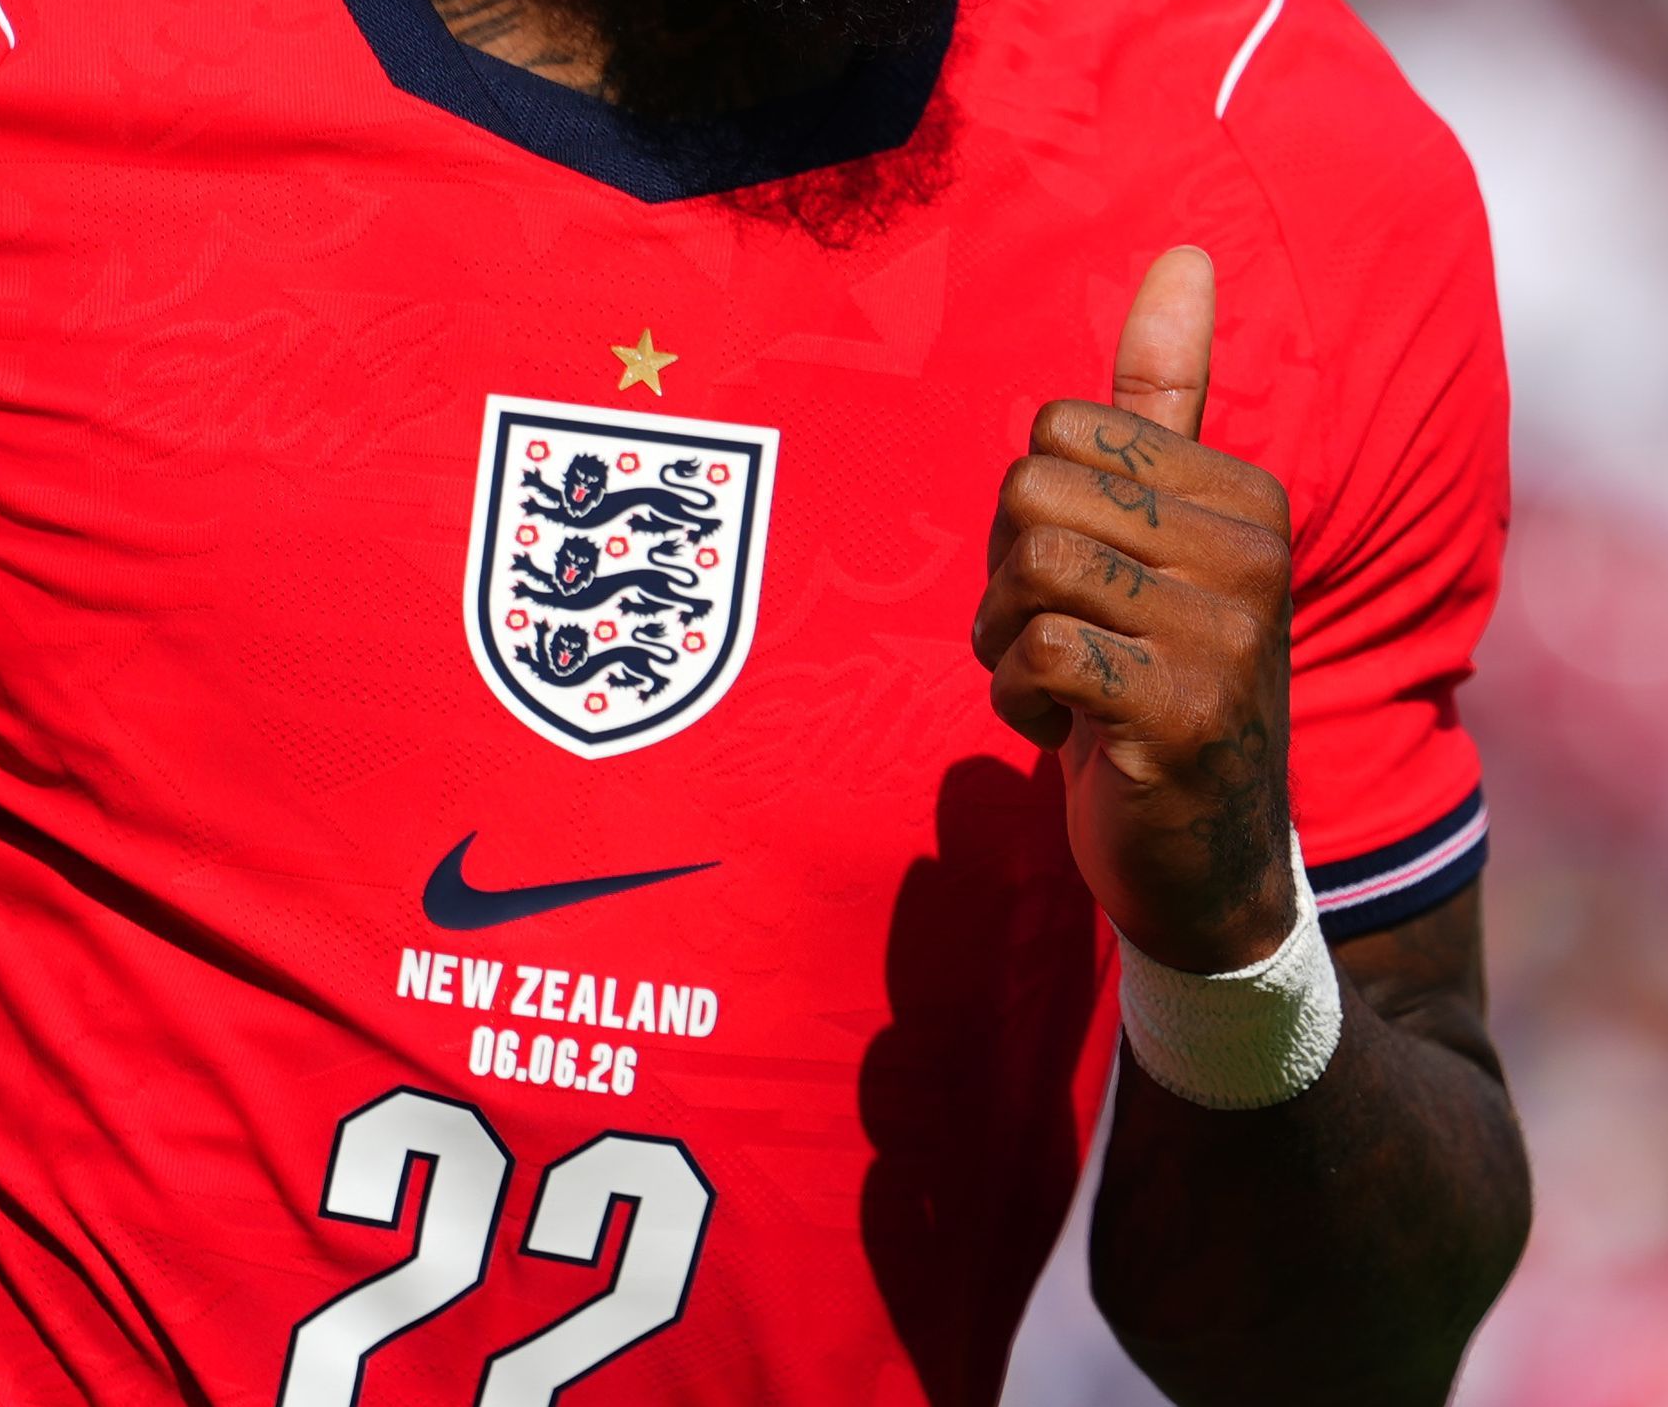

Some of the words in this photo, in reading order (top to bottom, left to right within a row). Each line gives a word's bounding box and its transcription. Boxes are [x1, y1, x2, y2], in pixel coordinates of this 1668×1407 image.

[396, 947, 504, 1011] NEW
[510, 965, 719, 1039] ZEALAND
[468, 1025, 638, 1097] 06.06.26
[278, 1086, 717, 1407] 22
